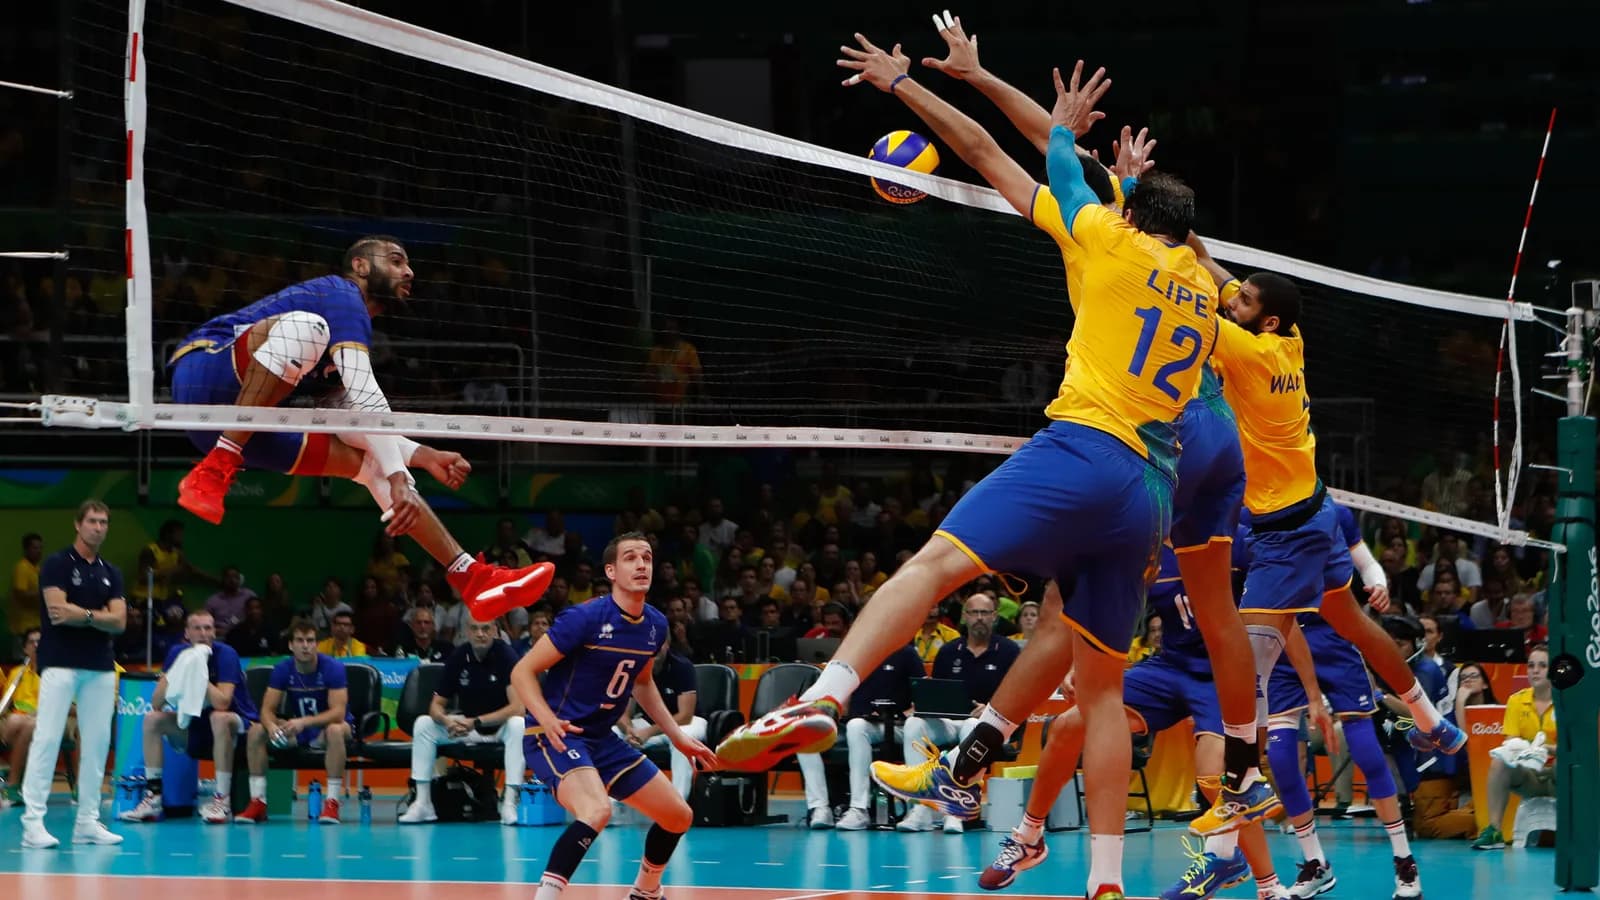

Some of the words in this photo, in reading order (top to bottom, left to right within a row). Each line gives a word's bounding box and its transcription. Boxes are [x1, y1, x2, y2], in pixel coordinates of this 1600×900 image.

[1147, 269, 1208, 319] LIPE
[1128, 306, 1202, 402] 12
[606, 659, 636, 698] 6
[117, 695, 172, 715] Rio20
[299, 697, 319, 718] 13
[567, 749, 581, 760] 6
